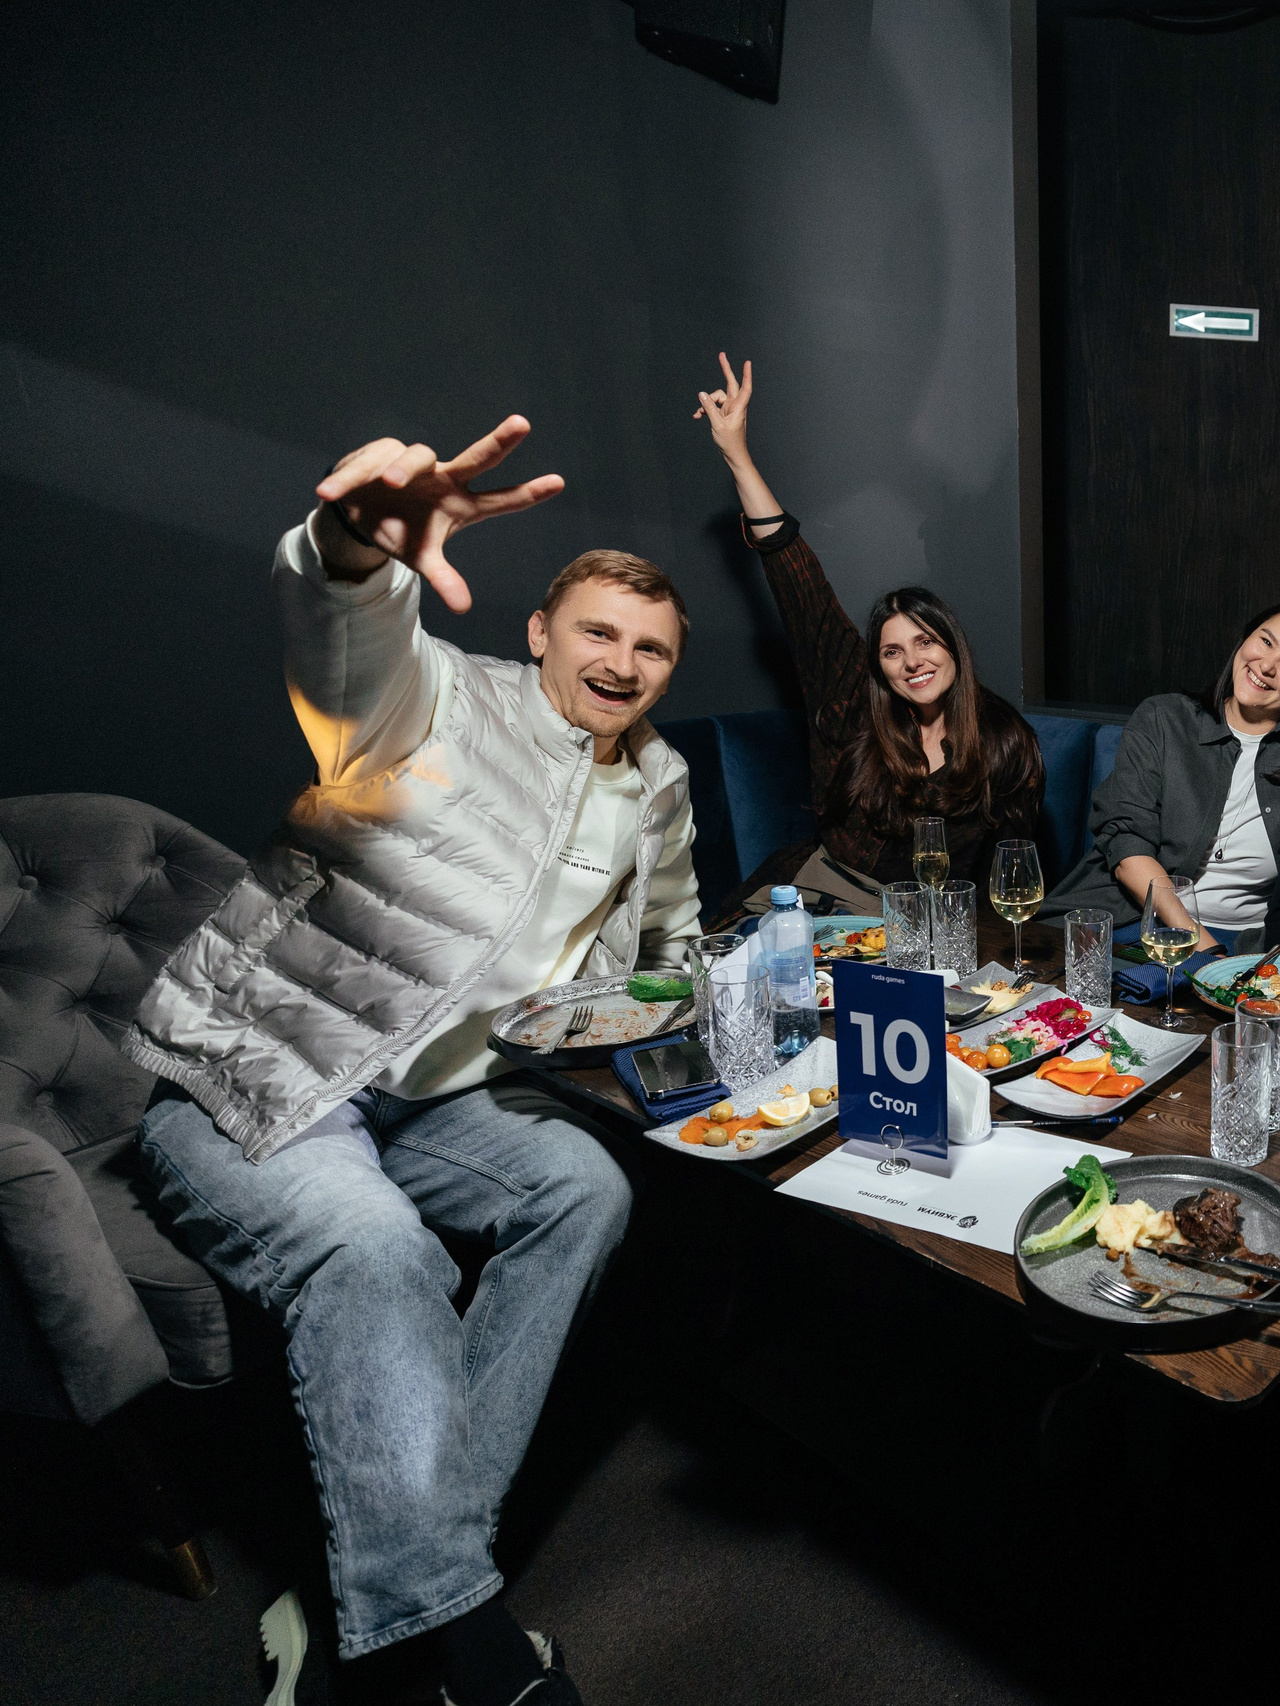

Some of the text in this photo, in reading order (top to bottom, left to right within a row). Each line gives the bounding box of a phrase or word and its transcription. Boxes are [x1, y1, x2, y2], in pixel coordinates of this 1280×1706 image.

[850, 1011, 930, 1084] 10
[869, 1091, 917, 1117] Стол
[857, 1190, 887, 1201] games
[917, 1206, 958, 1221] ЭКВИУМ
